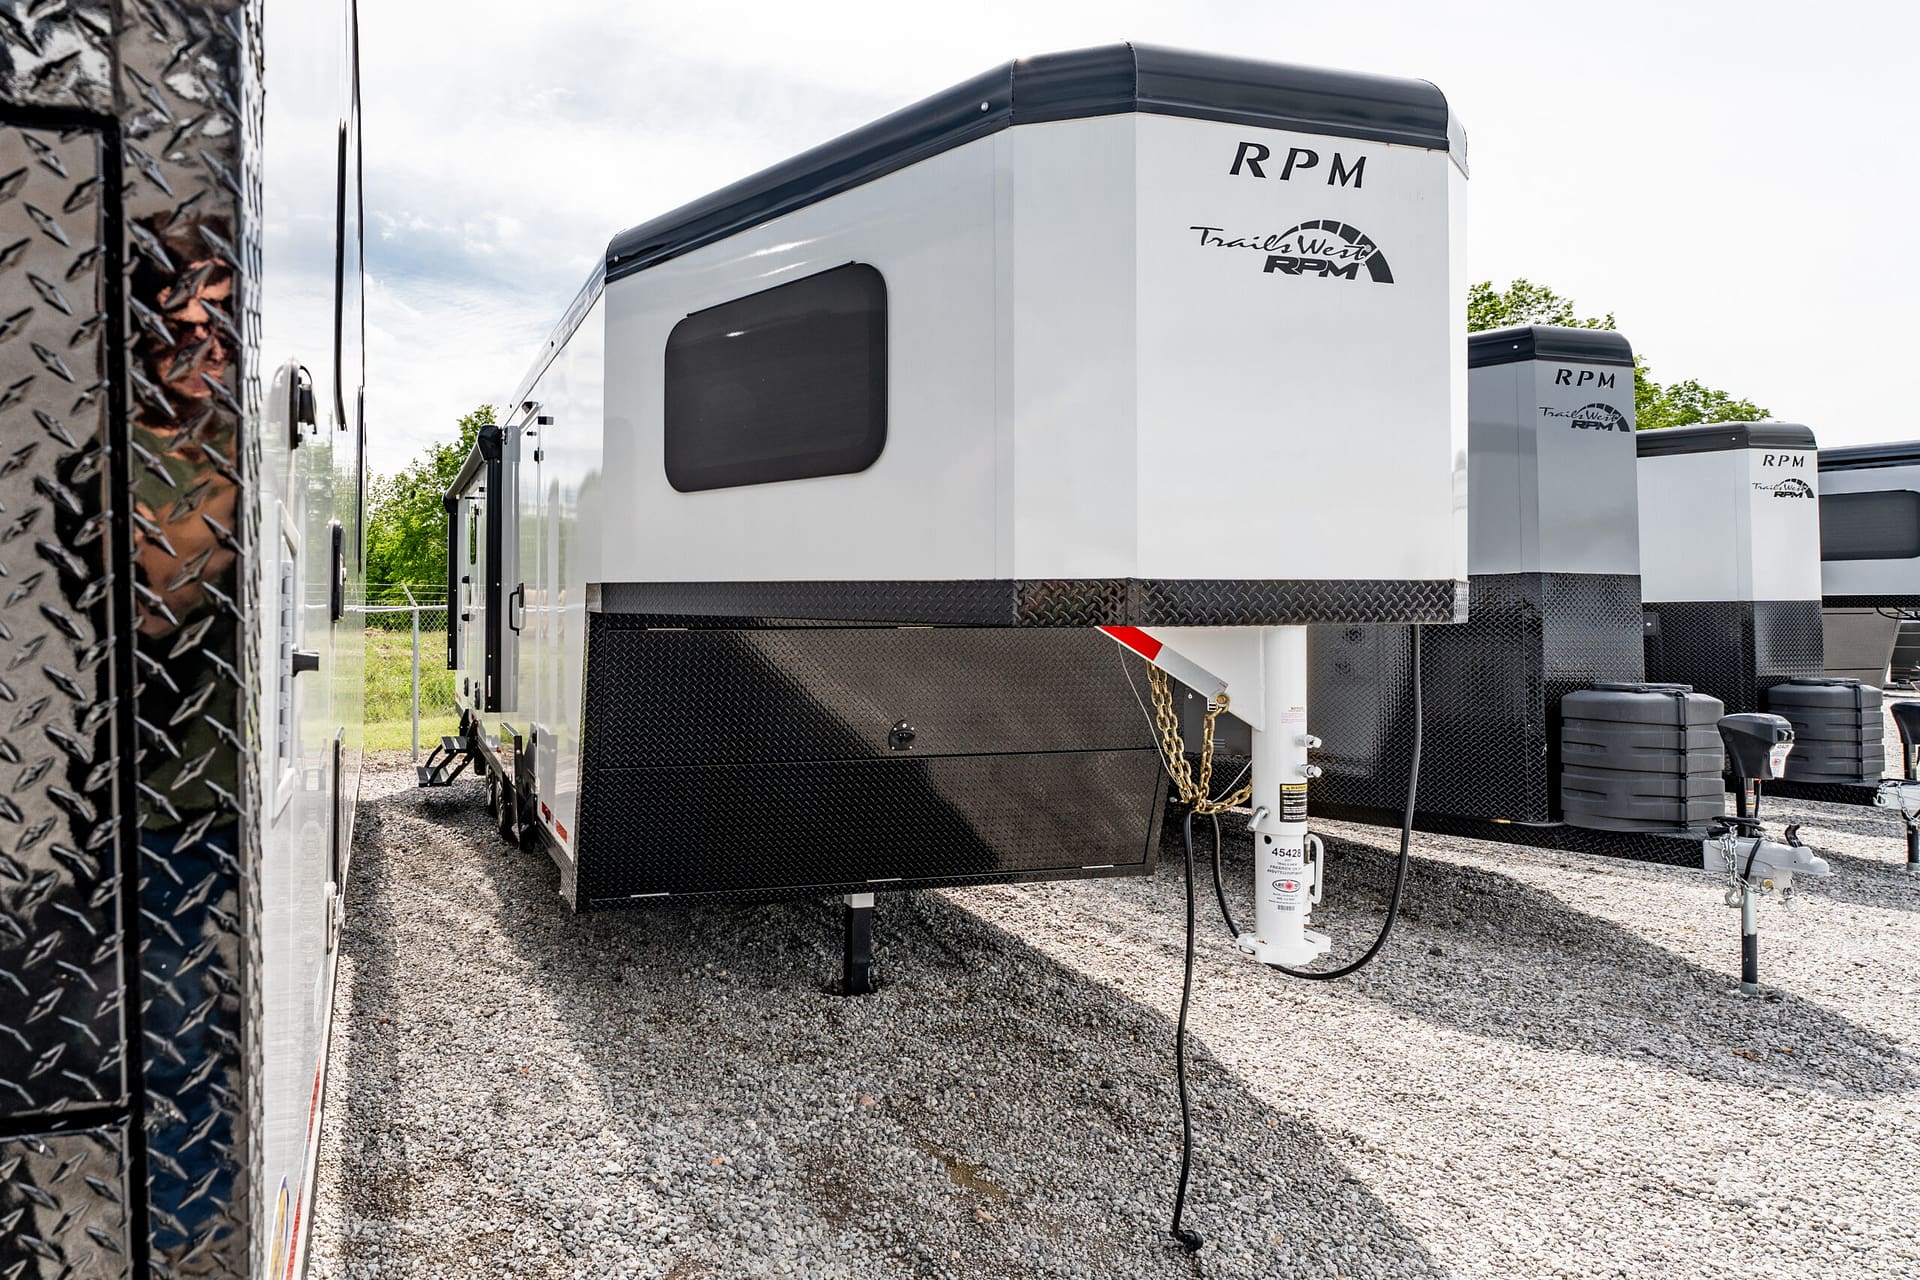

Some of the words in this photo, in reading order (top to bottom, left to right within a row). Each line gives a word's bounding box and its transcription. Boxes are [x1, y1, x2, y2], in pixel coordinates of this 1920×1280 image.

[1229, 141, 1367, 188] RPM
[1189, 226, 1293, 253] Trails
[1297, 234, 1368, 261] West
[1263, 255, 1360, 280] RPM
[1555, 368, 1616, 389] RPM
[1538, 406, 1584, 420] Trails
[1585, 410, 1619, 422] West
[1571, 420, 1615, 431] RPM
[1763, 454, 1804, 467] RPM
